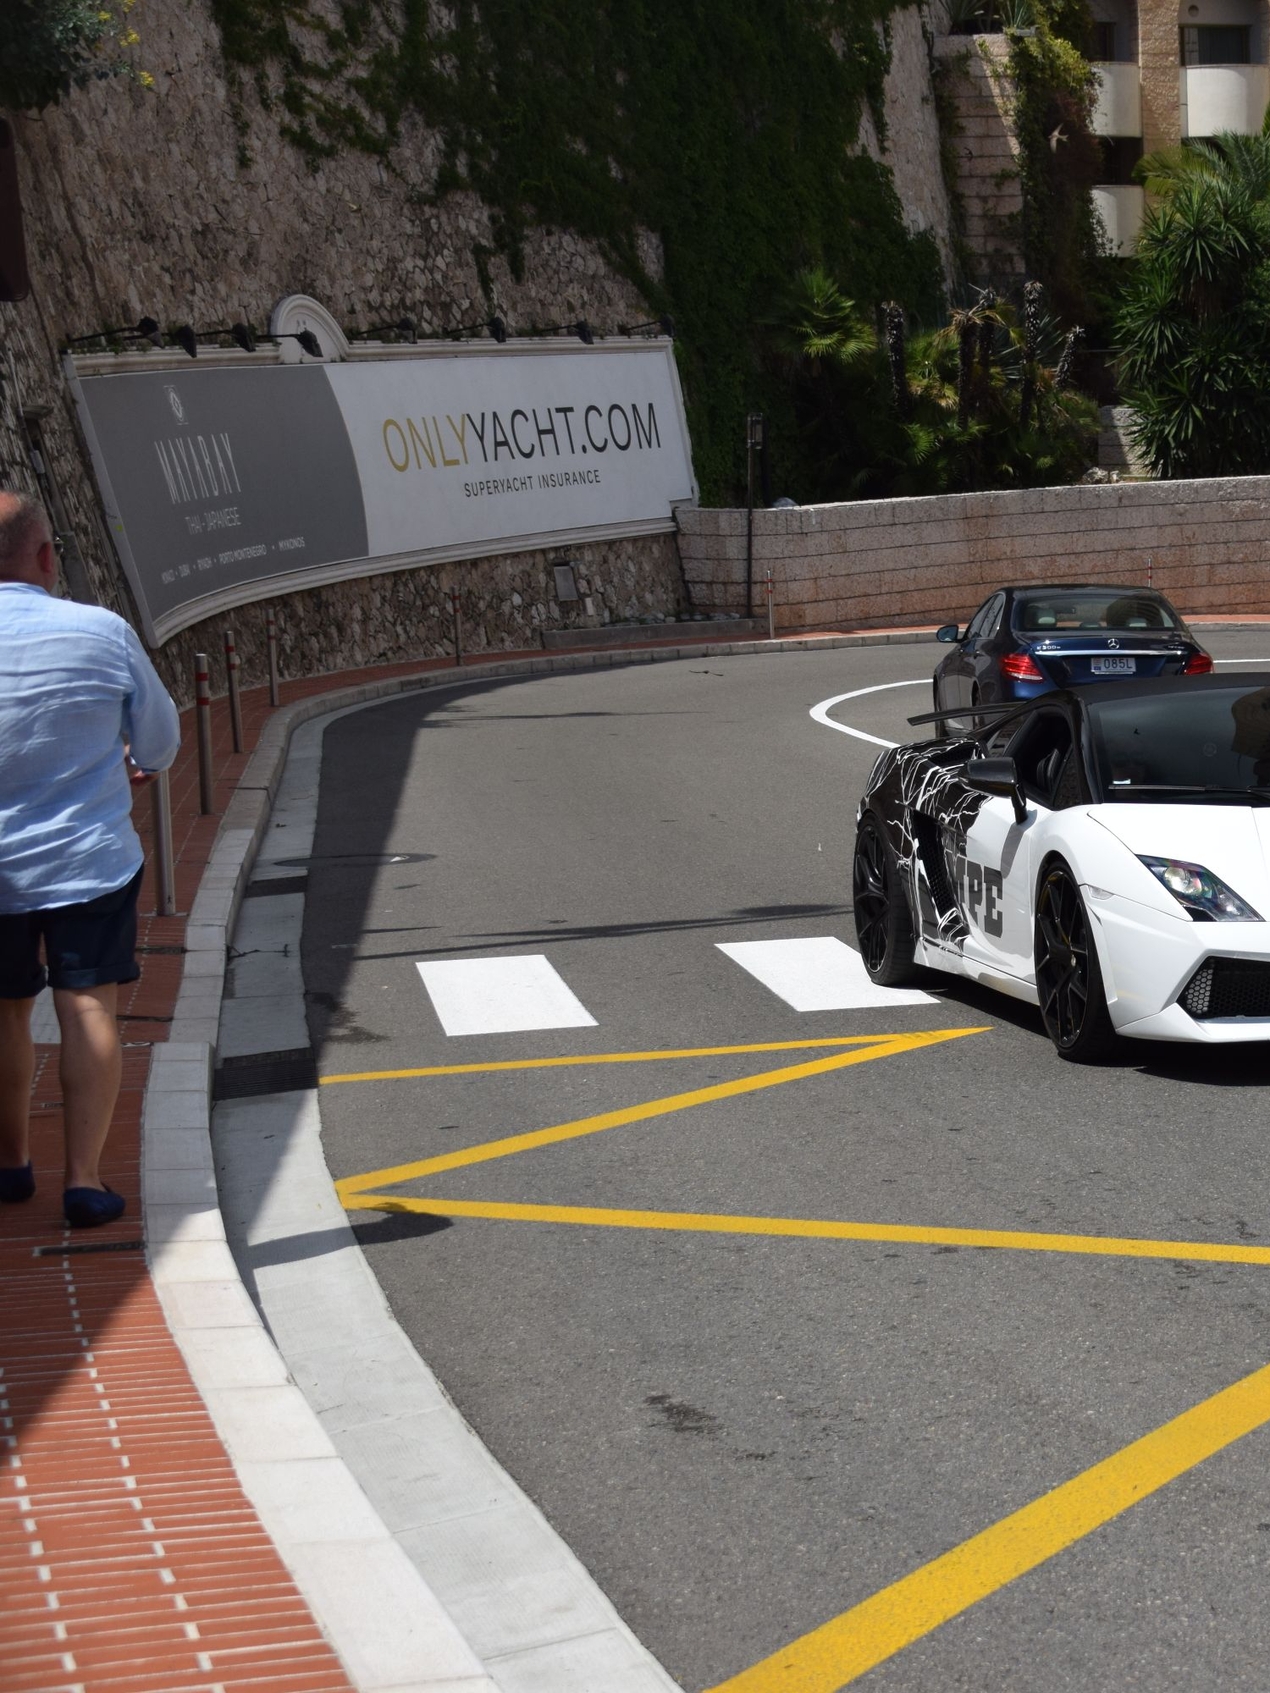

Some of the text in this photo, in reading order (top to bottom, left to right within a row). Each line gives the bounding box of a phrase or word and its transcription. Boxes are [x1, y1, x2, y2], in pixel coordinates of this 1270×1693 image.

[464, 469, 601, 498] SUPERYACHT INSURANCE
[1104, 658, 1133, 669] 085L
